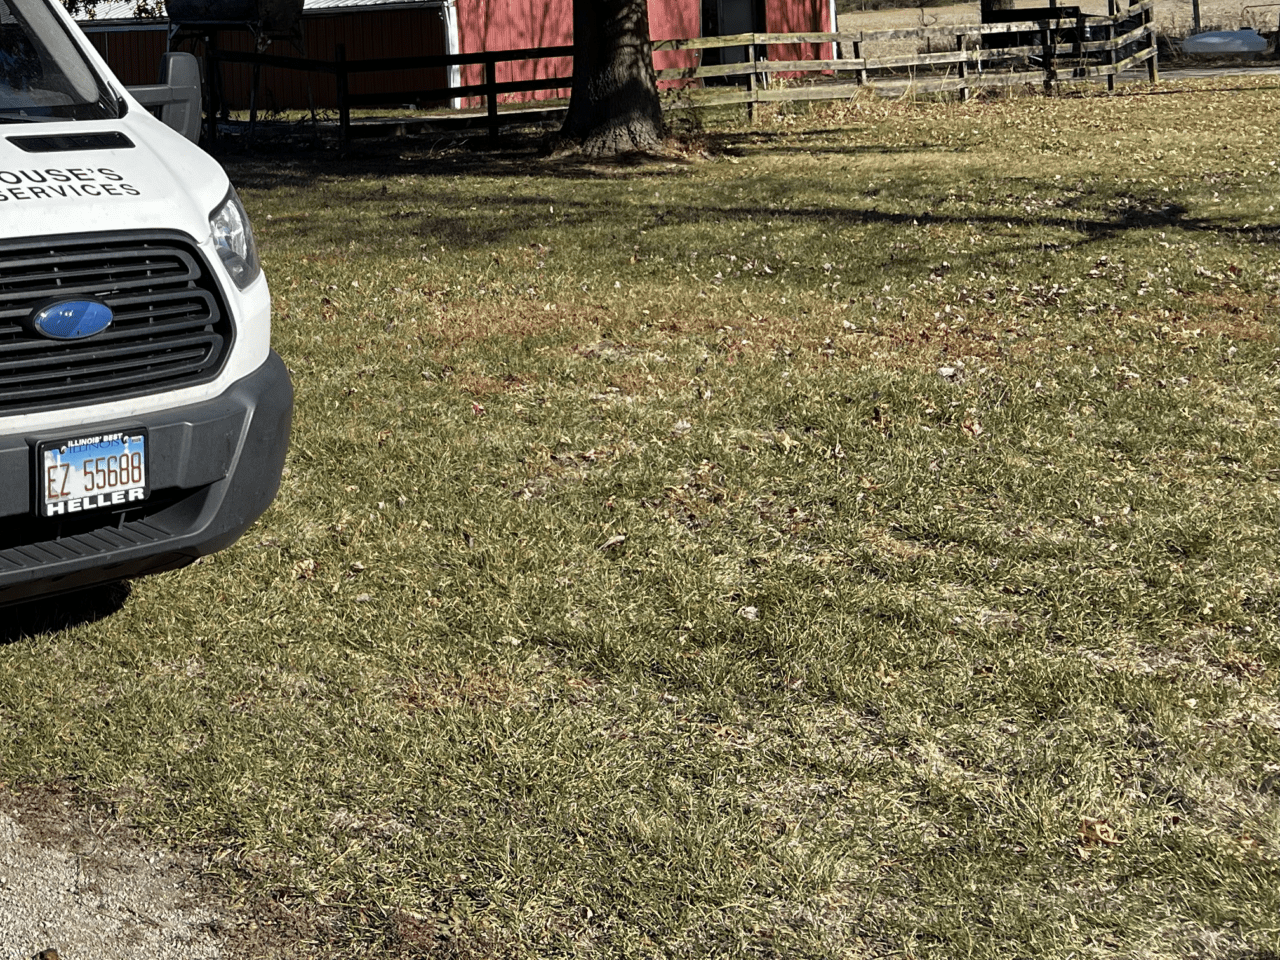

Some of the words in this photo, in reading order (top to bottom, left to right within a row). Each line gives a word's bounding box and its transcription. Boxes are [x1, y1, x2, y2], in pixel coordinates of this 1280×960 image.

[103, 433, 123, 442] BEST
[47, 462, 71, 499] EZ
[83, 452, 142, 491] 55688
[46, 488, 145, 517] HELLER
